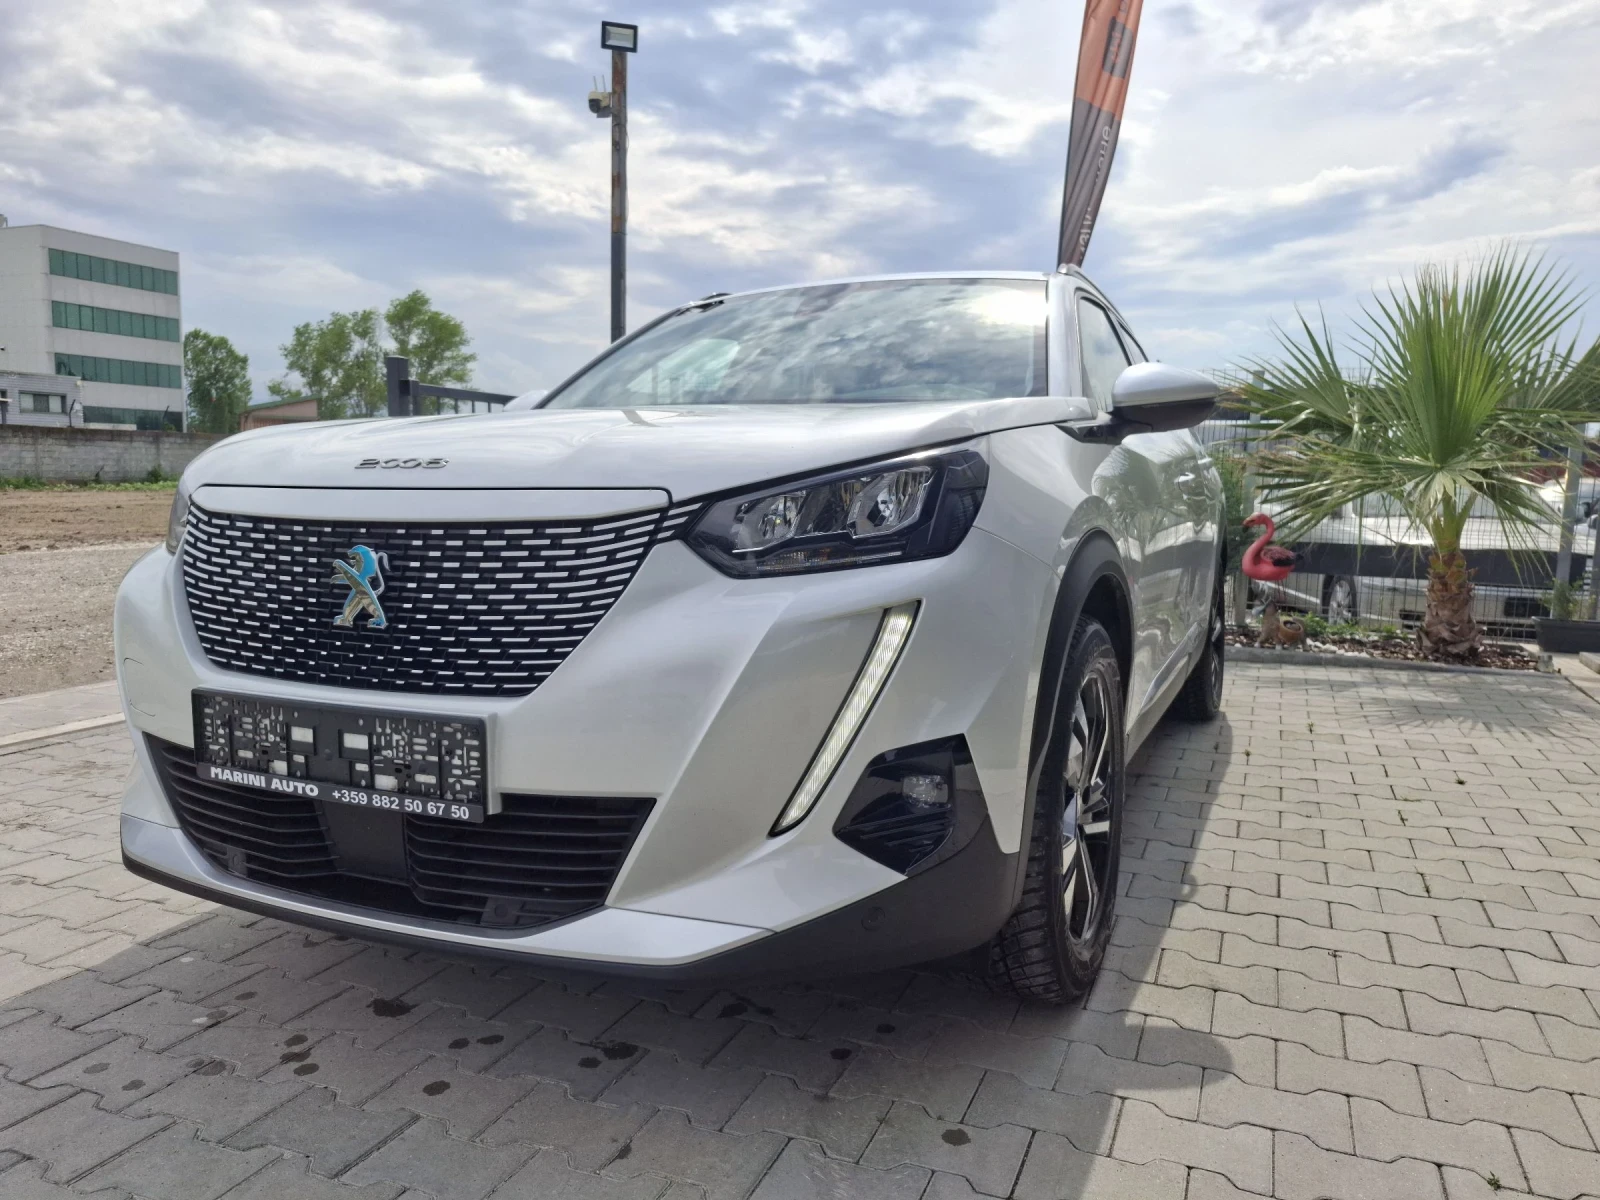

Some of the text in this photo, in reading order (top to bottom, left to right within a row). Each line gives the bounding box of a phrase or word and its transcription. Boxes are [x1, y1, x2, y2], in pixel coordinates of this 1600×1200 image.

[354, 458, 449, 469] 2008
[210, 766, 470, 819] MARINI AUTO +359 882 50 67 50
